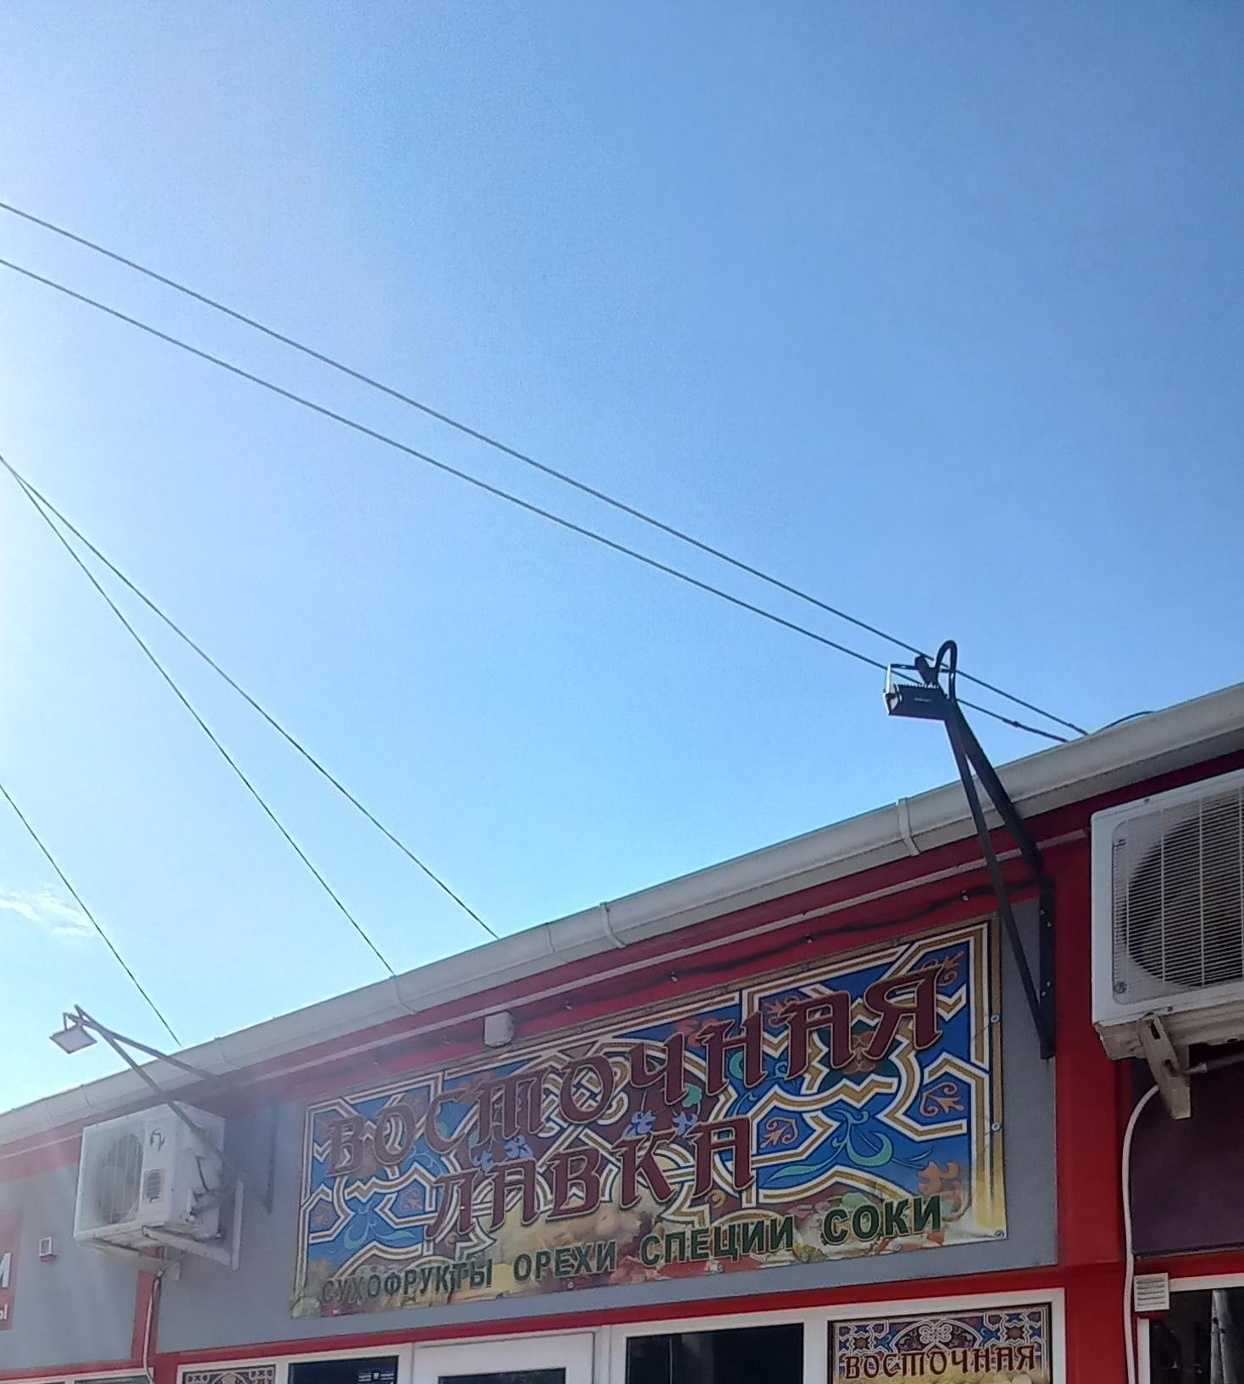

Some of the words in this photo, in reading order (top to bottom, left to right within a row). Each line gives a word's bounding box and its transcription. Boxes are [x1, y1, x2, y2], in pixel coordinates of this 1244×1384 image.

[325, 962, 947, 1178] ВОСТОЧНАЯ
[424, 1114, 756, 1240] ЛАВКА
[320, 1258, 493, 1304] СУХОФРУКТЫ
[512, 1239, 618, 1283] ОРЕХИ
[638, 1214, 795, 1268] СПЕЦИИ
[822, 1195, 943, 1246] СОКИ
[844, 1345, 1036, 1379] ВОСТОЧНАЯ
